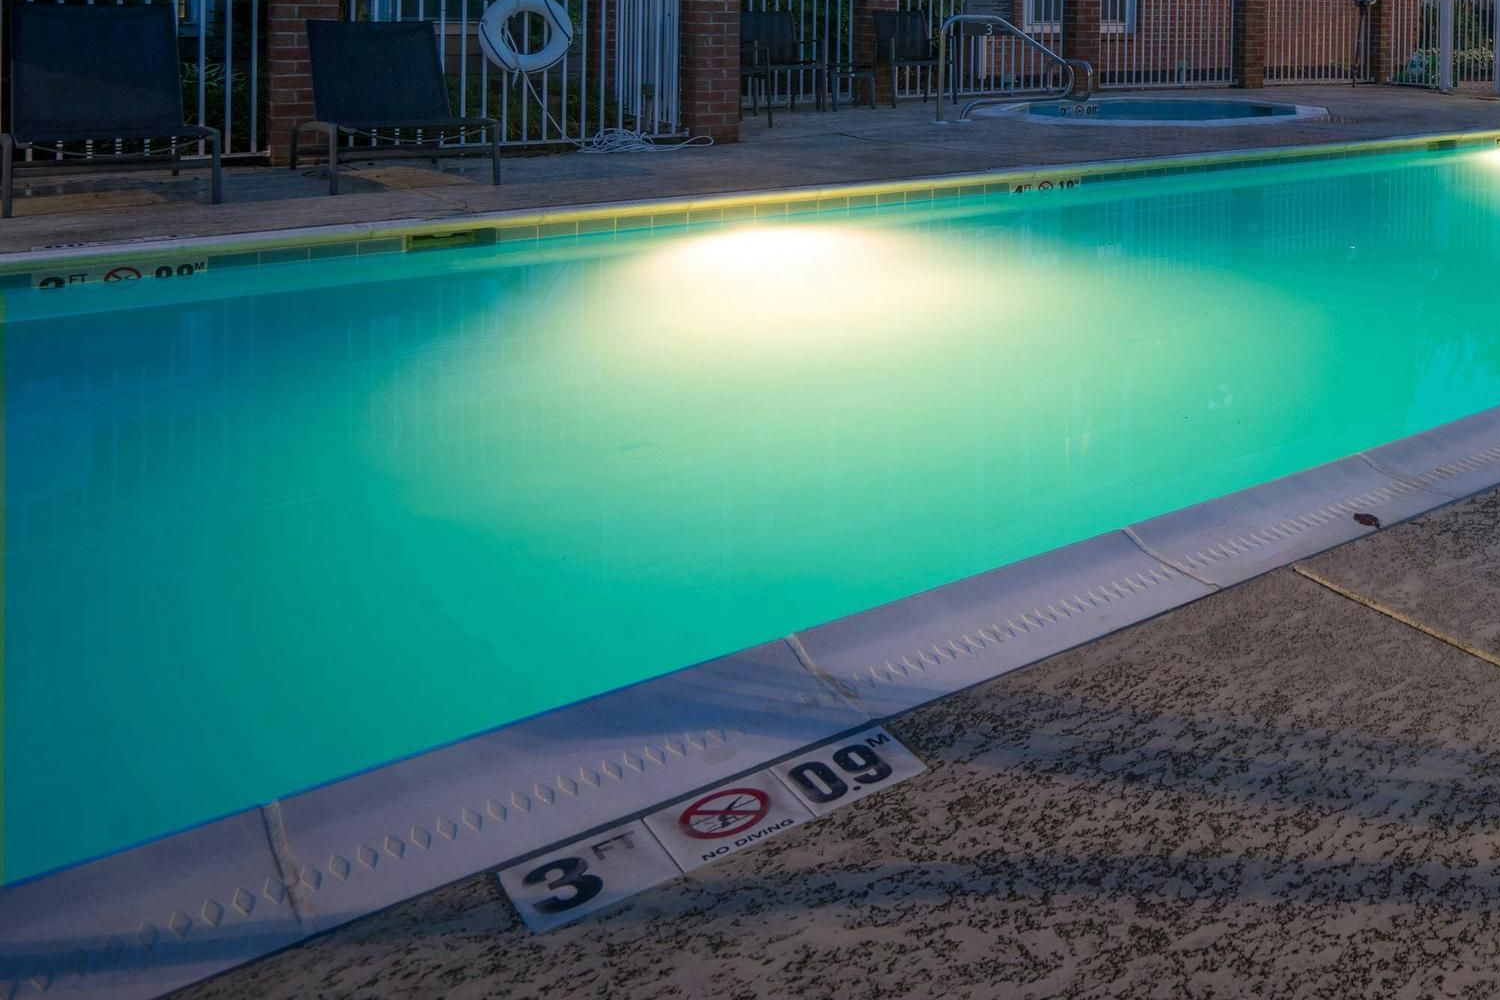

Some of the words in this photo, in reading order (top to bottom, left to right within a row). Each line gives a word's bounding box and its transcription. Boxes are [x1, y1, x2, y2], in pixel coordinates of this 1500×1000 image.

[985, 23, 993, 36] 3
[701, 844, 730, 862] NO
[733, 817, 796, 851] DIVING
